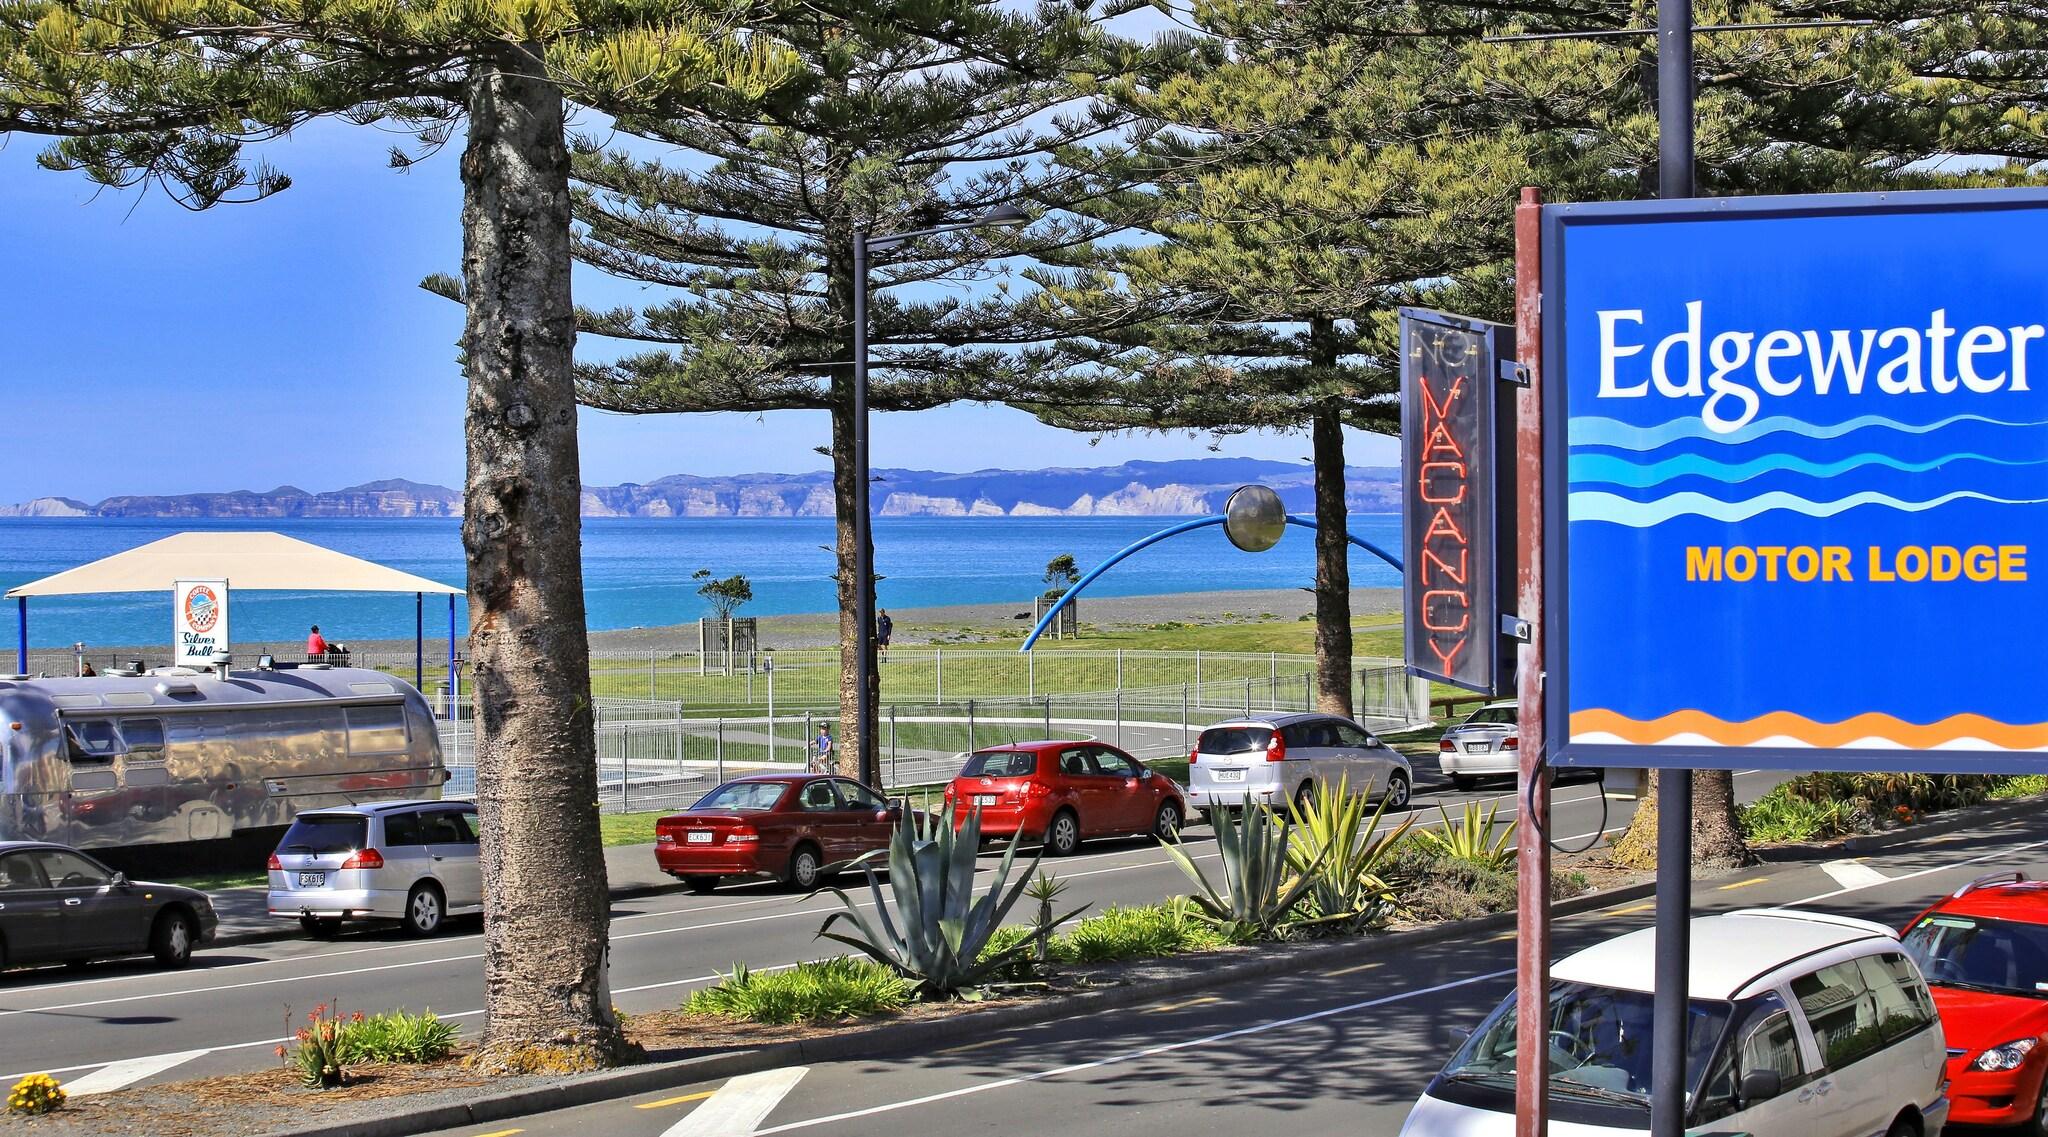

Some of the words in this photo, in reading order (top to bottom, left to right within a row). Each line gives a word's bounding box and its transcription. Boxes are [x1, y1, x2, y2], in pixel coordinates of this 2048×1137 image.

[1411, 329, 1474, 367] NO
[1596, 300, 2045, 434] Edgewater
[1418, 375, 1468, 677] VACANCY
[1685, 546, 1853, 582] MOTOR
[1868, 545, 2028, 582] LODGE
[189, 586, 209, 599] COFFEE
[181, 632, 216, 645] Silver
[186, 645, 214, 657] Bull
